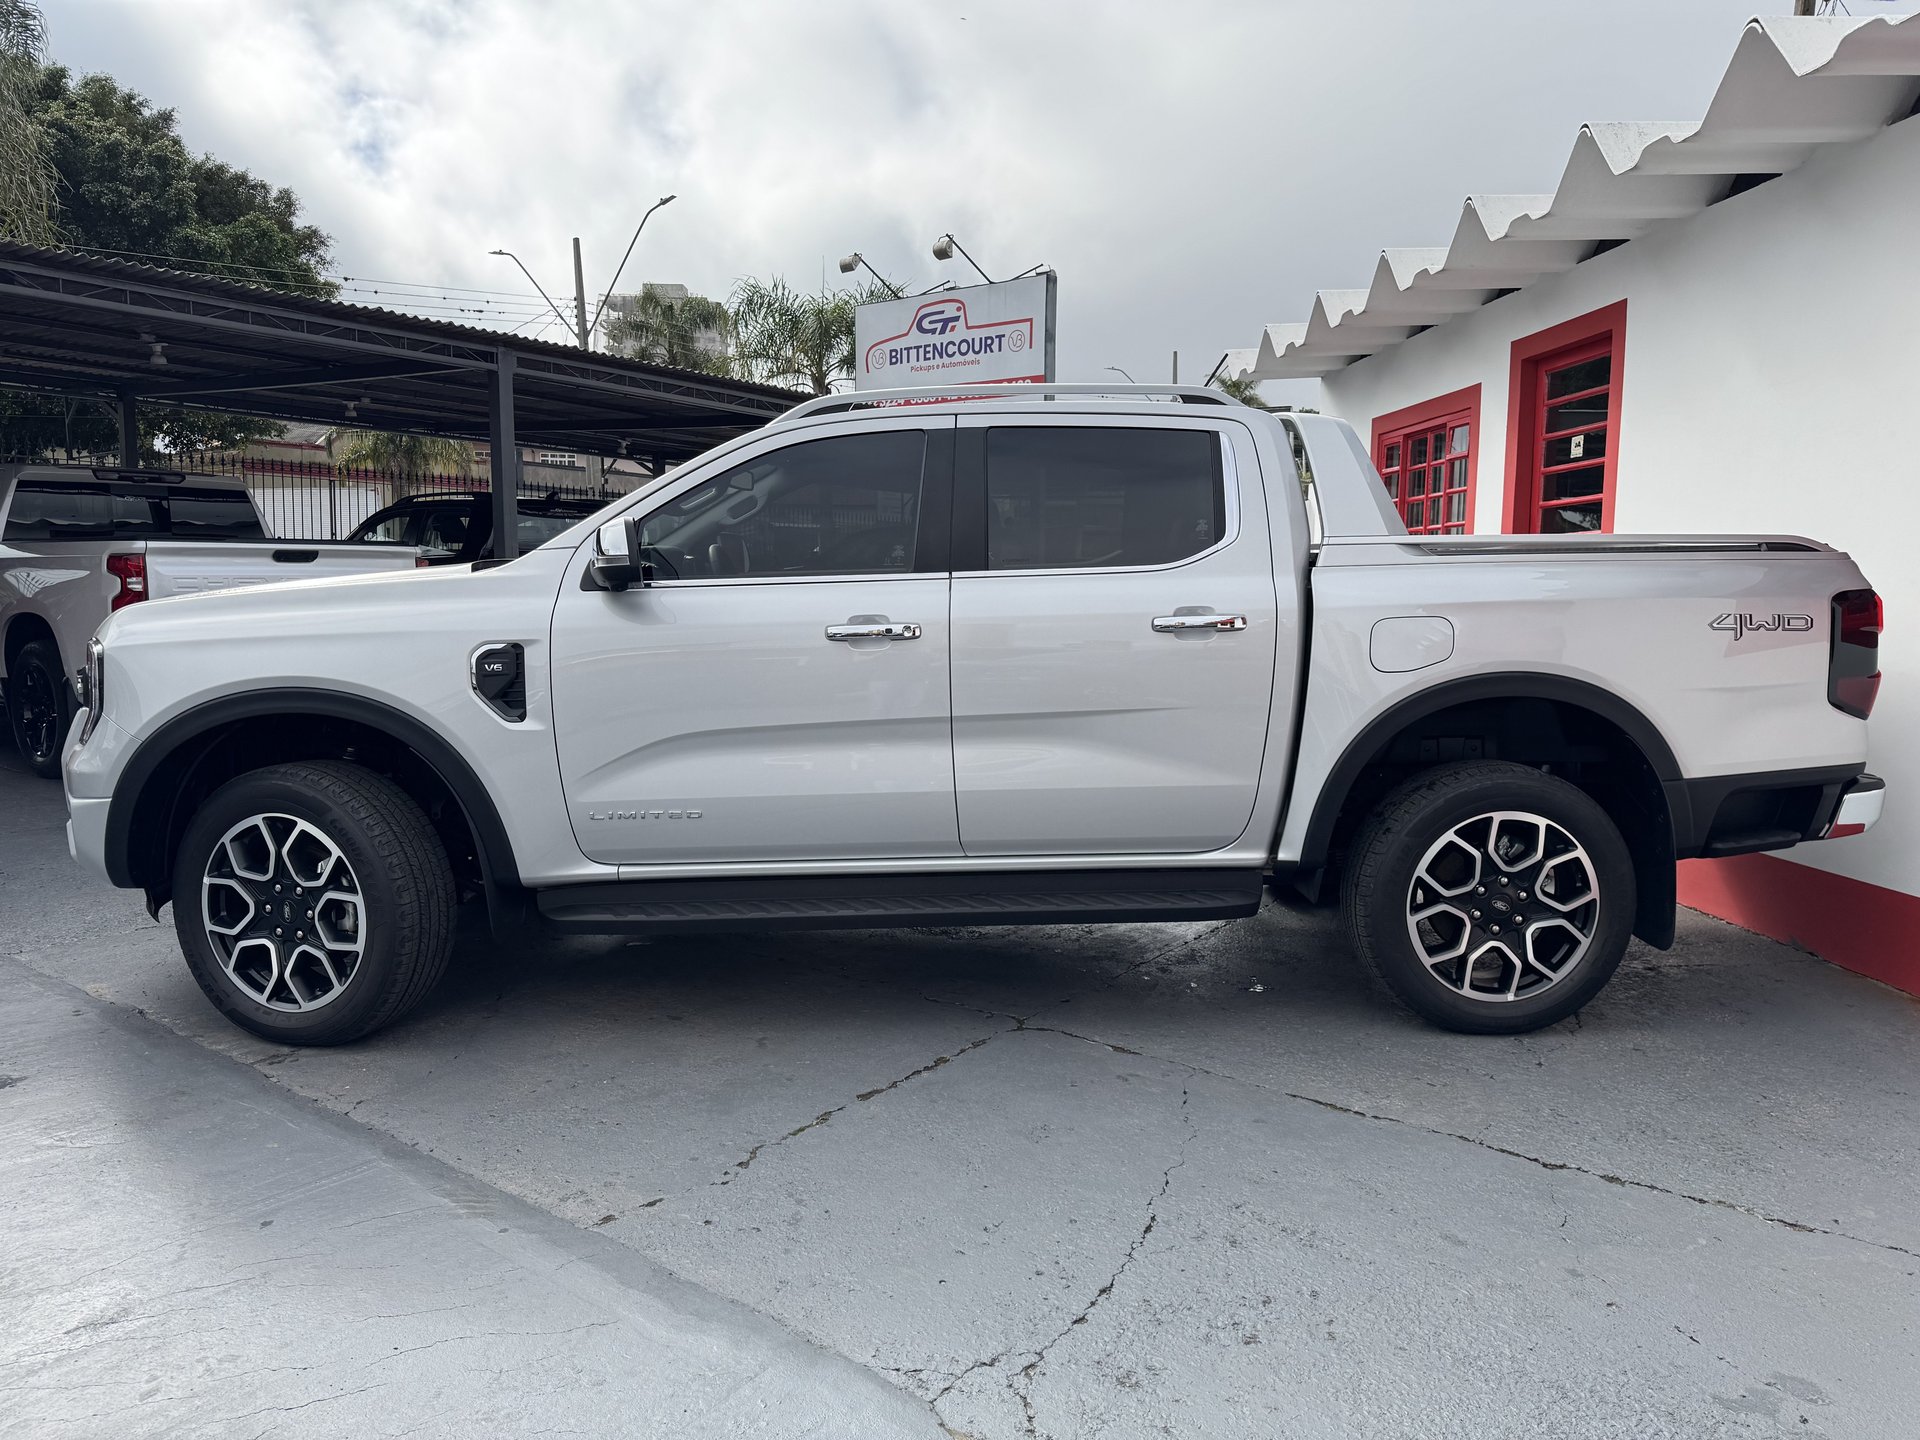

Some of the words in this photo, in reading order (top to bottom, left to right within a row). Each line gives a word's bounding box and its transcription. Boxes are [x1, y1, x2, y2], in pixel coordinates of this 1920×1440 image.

[889, 334, 1006, 366] BITTENCOURT
[910, 364, 936, 373] Pickups
[940, 358, 981, 369] Automóveis
[1707, 613, 1814, 641] 4WD
[484, 663, 503, 672] V6
[589, 809, 703, 821] LIMITED
